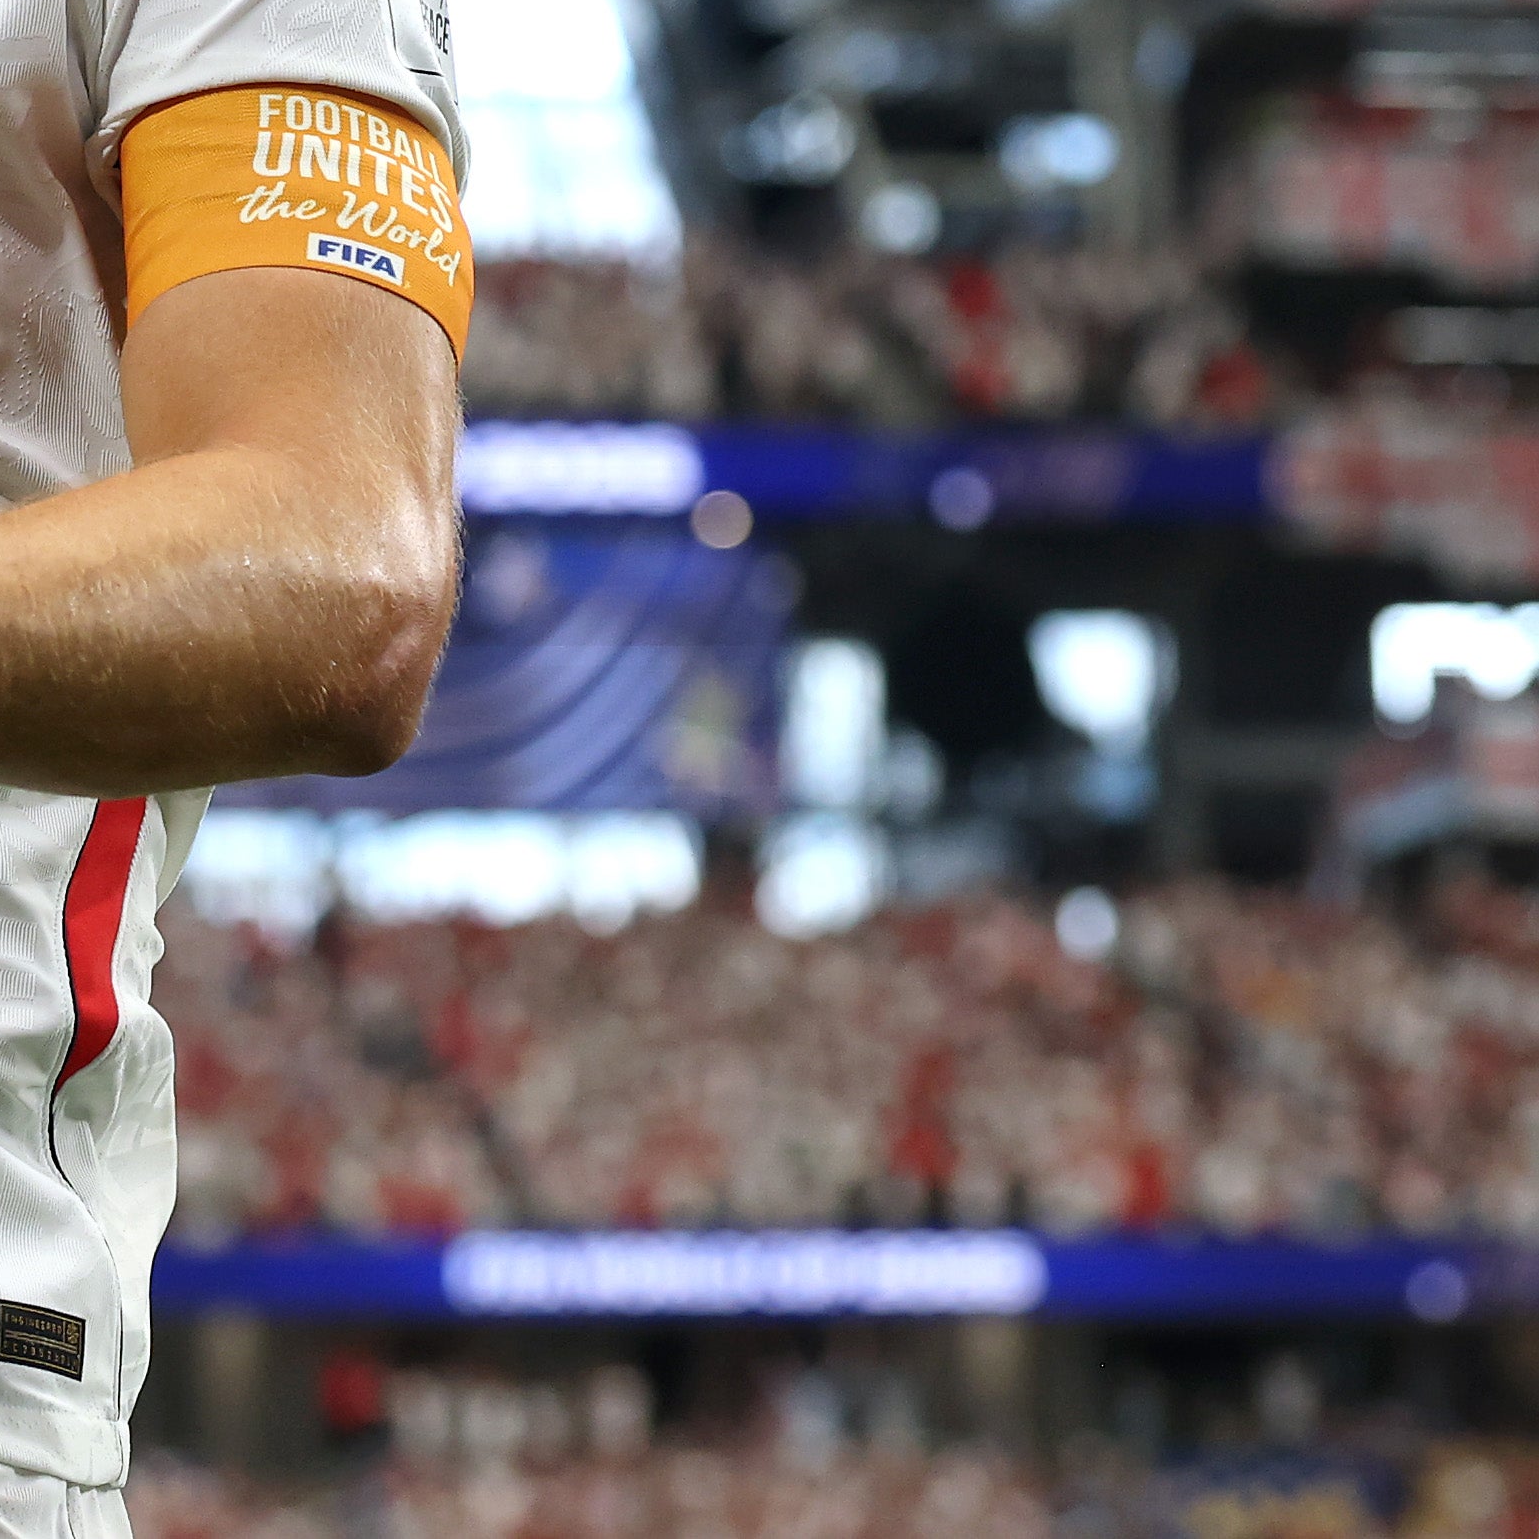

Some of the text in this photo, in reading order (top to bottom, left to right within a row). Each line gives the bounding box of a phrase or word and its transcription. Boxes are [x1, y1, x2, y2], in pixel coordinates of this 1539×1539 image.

[253, 131, 454, 233] UNITES
[258, 94, 448, 192] FOOTBALL
[234, 180, 461, 287] the World
[318, 239, 397, 279] FIFA
